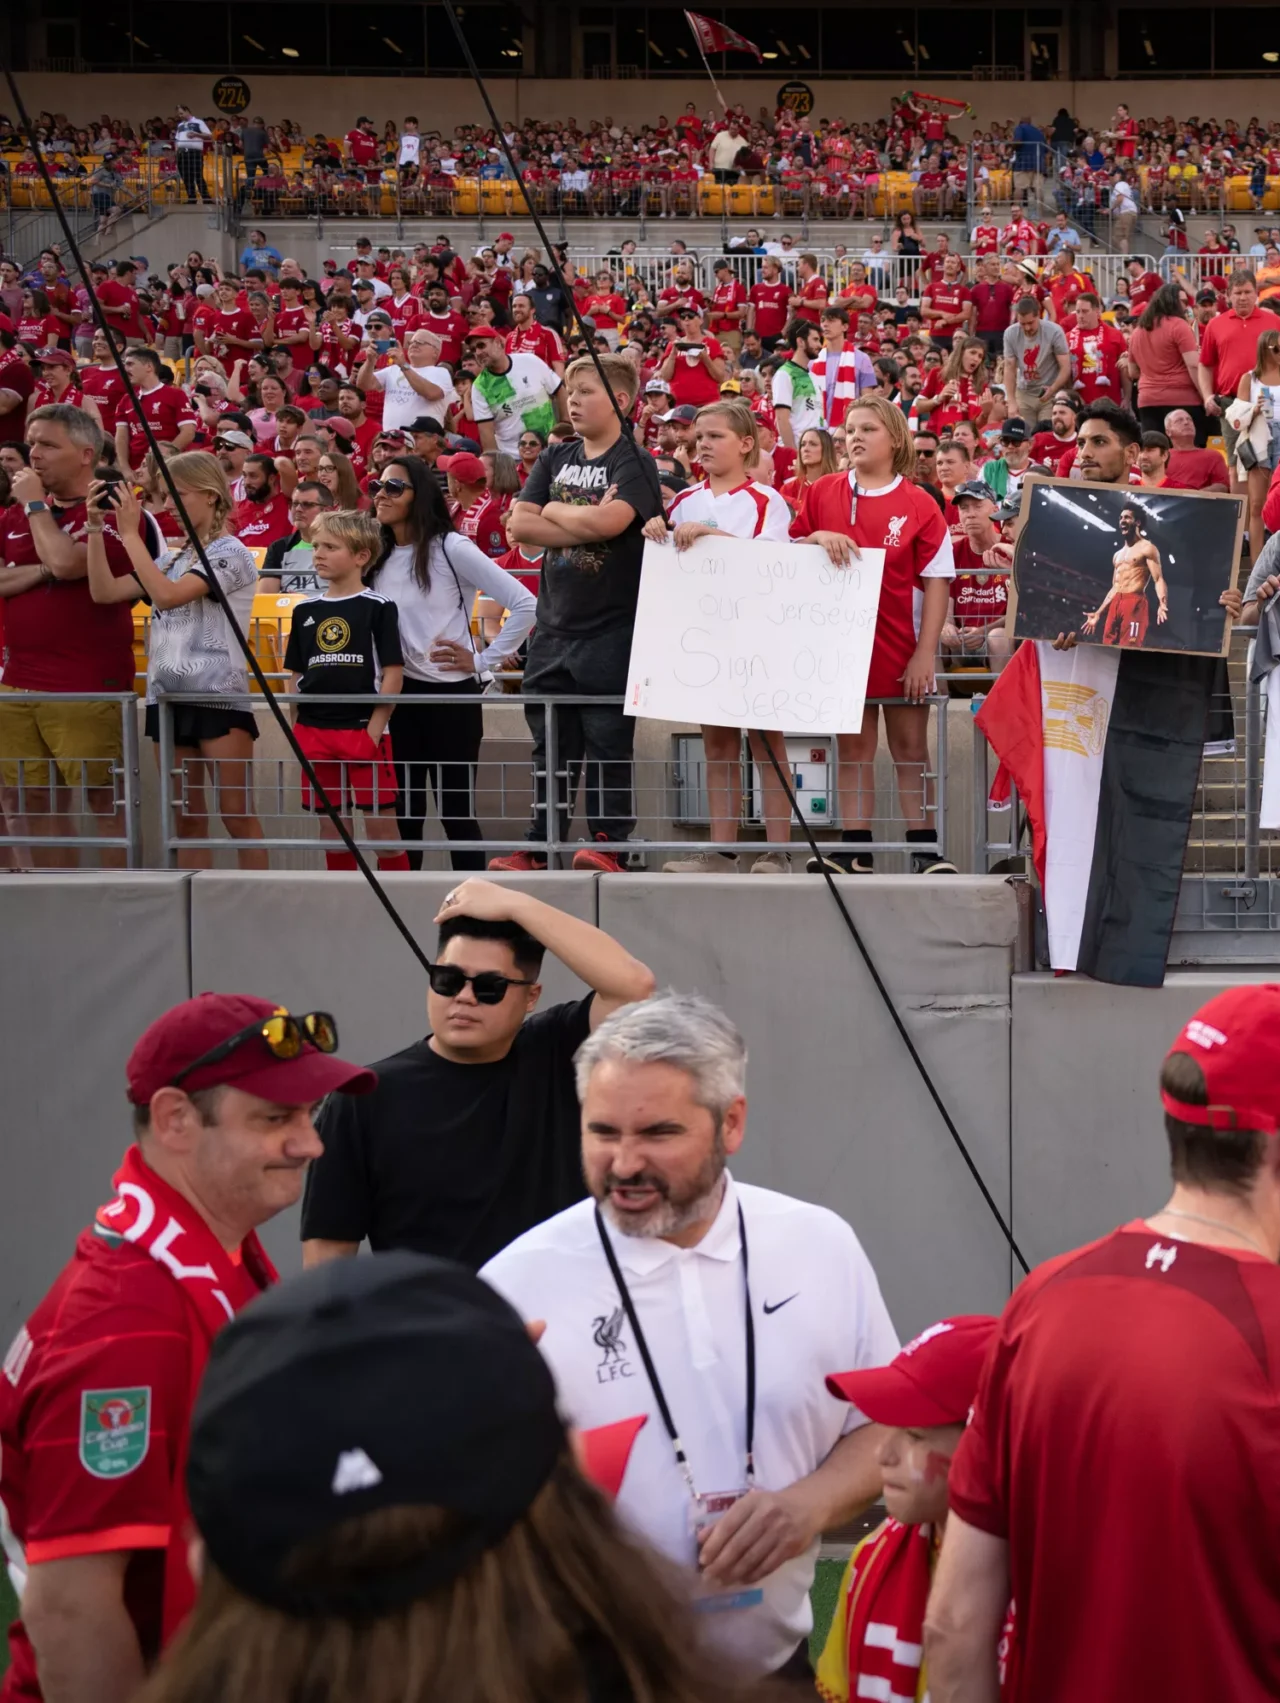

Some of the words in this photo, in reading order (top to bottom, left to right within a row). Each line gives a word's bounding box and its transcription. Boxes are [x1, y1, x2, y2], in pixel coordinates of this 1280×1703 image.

[218, 88, 247, 108] 224
[677, 550, 727, 576] Can
[756, 558, 798, 595] you
[1130, 621, 1140, 638] 11
[672, 626, 771, 688] Sign
